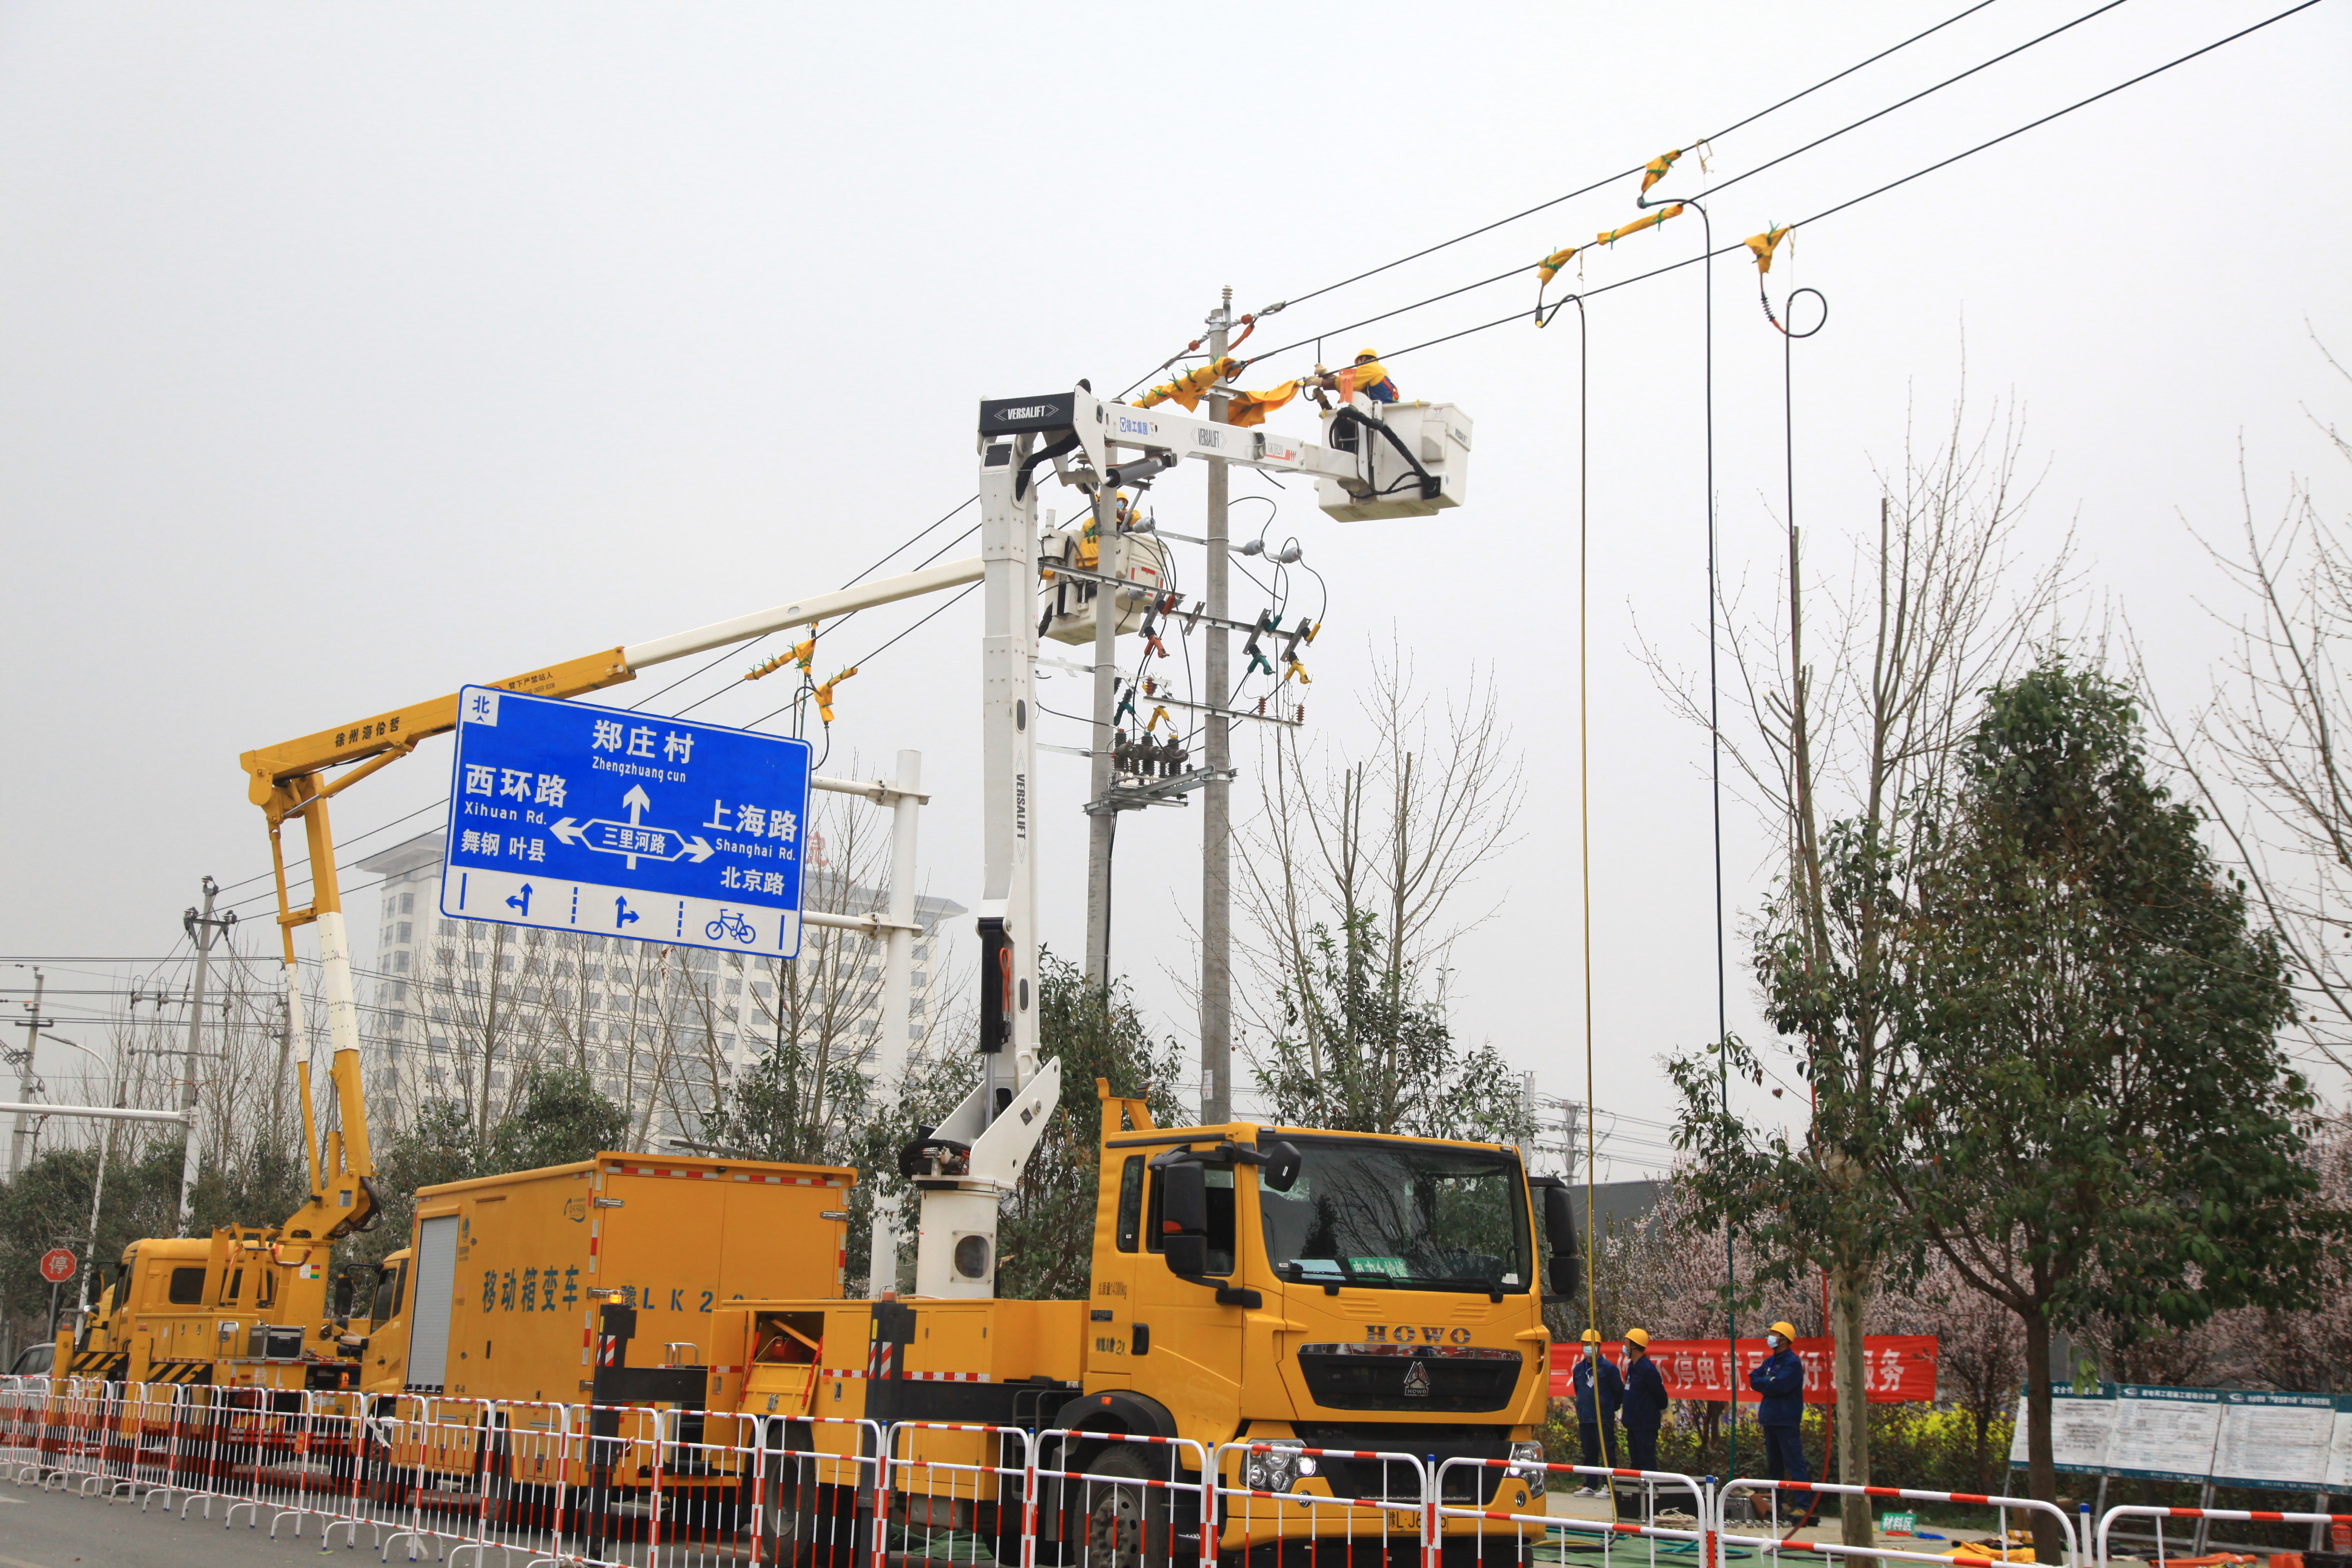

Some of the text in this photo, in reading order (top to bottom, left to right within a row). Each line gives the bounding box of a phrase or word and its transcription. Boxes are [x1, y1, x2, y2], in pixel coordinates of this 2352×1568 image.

[1007, 405, 1046, 420] VERSALIFT
[1126, 419, 1148, 435] 徐工集团
[1197, 427, 1220, 448] VERSALIFT
[508, 672, 553, 690] 臂下严禁站人
[534, 685, 545, 693] UNDER
[545, 682, 555, 690] BOOM
[472, 695, 490, 714] 北
[335, 716, 399, 748] 徐州海伦哲
[591, 719, 695, 764] 郑庄村
[592, 756, 686, 783] Zhengzhuang cun
[465, 763, 567, 808] 西环路
[464, 801, 547, 825] Xihuan Rd.
[1016, 774, 1026, 840] VERSALIFT
[703, 799, 798, 842] 上海路
[461, 828, 546, 862] 舞钢 叶县
[602, 826, 666, 855] 三里河路
[715, 838, 796, 861] Shanghai Rd.
[720, 866, 785, 896] 北京路
[48, 1256, 67, 1274] 停
[483, 1264, 579, 1314] 移动箱变车
[1365, 1325, 1471, 1345] HOWO
[1883, 1516, 1913, 1531] 材料区
